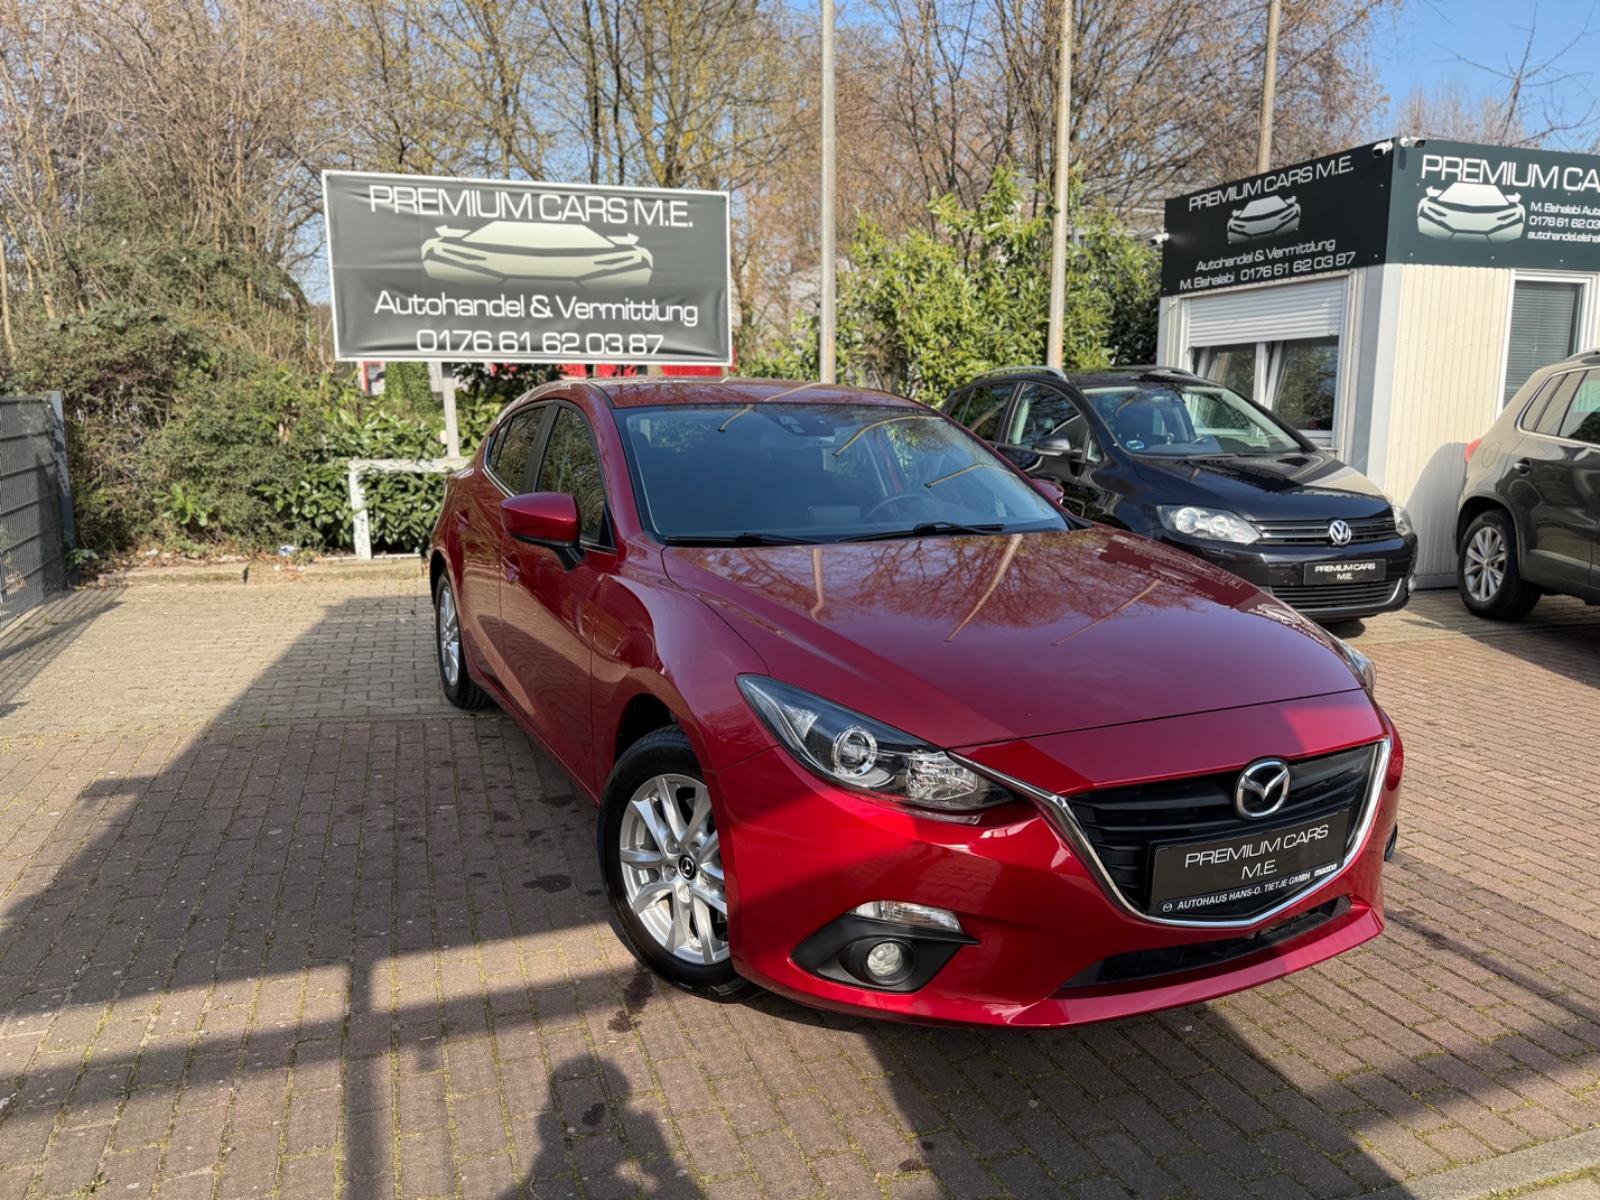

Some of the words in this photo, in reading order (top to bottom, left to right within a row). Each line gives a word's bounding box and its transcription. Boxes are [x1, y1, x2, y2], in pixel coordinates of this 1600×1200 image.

[1189, 179, 1262, 212] PREMIUM
[1264, 166, 1313, 193] CARS
[1316, 155, 1355, 180] M.E.
[1421, 154, 1560, 190] PREMIUM
[1563, 167, 1600, 193] CA
[369, 184, 533, 220] PREMIUM
[538, 193, 629, 224] CARS
[633, 198, 694, 228] M.E.
[1529, 215, 1556, 227] 0176
[1556, 217, 1569, 228] 61
[1571, 218, 1586, 229] 62
[1530, 201, 1543, 212] M.
[1180, 278, 1193, 291] M.
[1240, 265, 1272, 281] 0176
[1273, 262, 1290, 276] 61
[1293, 259, 1312, 273] 62
[1313, 255, 1334, 270] 03
[1336, 251, 1356, 266] 87
[1195, 251, 1254, 272] Autohandel
[1254, 249, 1265, 262] &
[1266, 239, 1336, 260] Vermittlung
[374, 290, 526, 318] Autohandel
[530, 294, 553, 318] &
[555, 295, 699, 327] Vermittlung
[416, 329, 493, 353] 0176
[498, 331, 532, 354] 61
[541, 332, 581, 355] 62
[586, 333, 624, 356] 03
[628, 334, 664, 356] 87
[1315, 564, 1353, 573] PREMIUM
[1353, 562, 1376, 571] CARS
[1184, 837, 1282, 868] PREMIUM
[1283, 824, 1329, 849] CARS
[1241, 859, 1278, 880] M.E.
[1177, 893, 1227, 910] AUTOHAUS
[1228, 886, 1262, 901] HANS-O.
[1264, 878, 1288, 893] TIETJE
